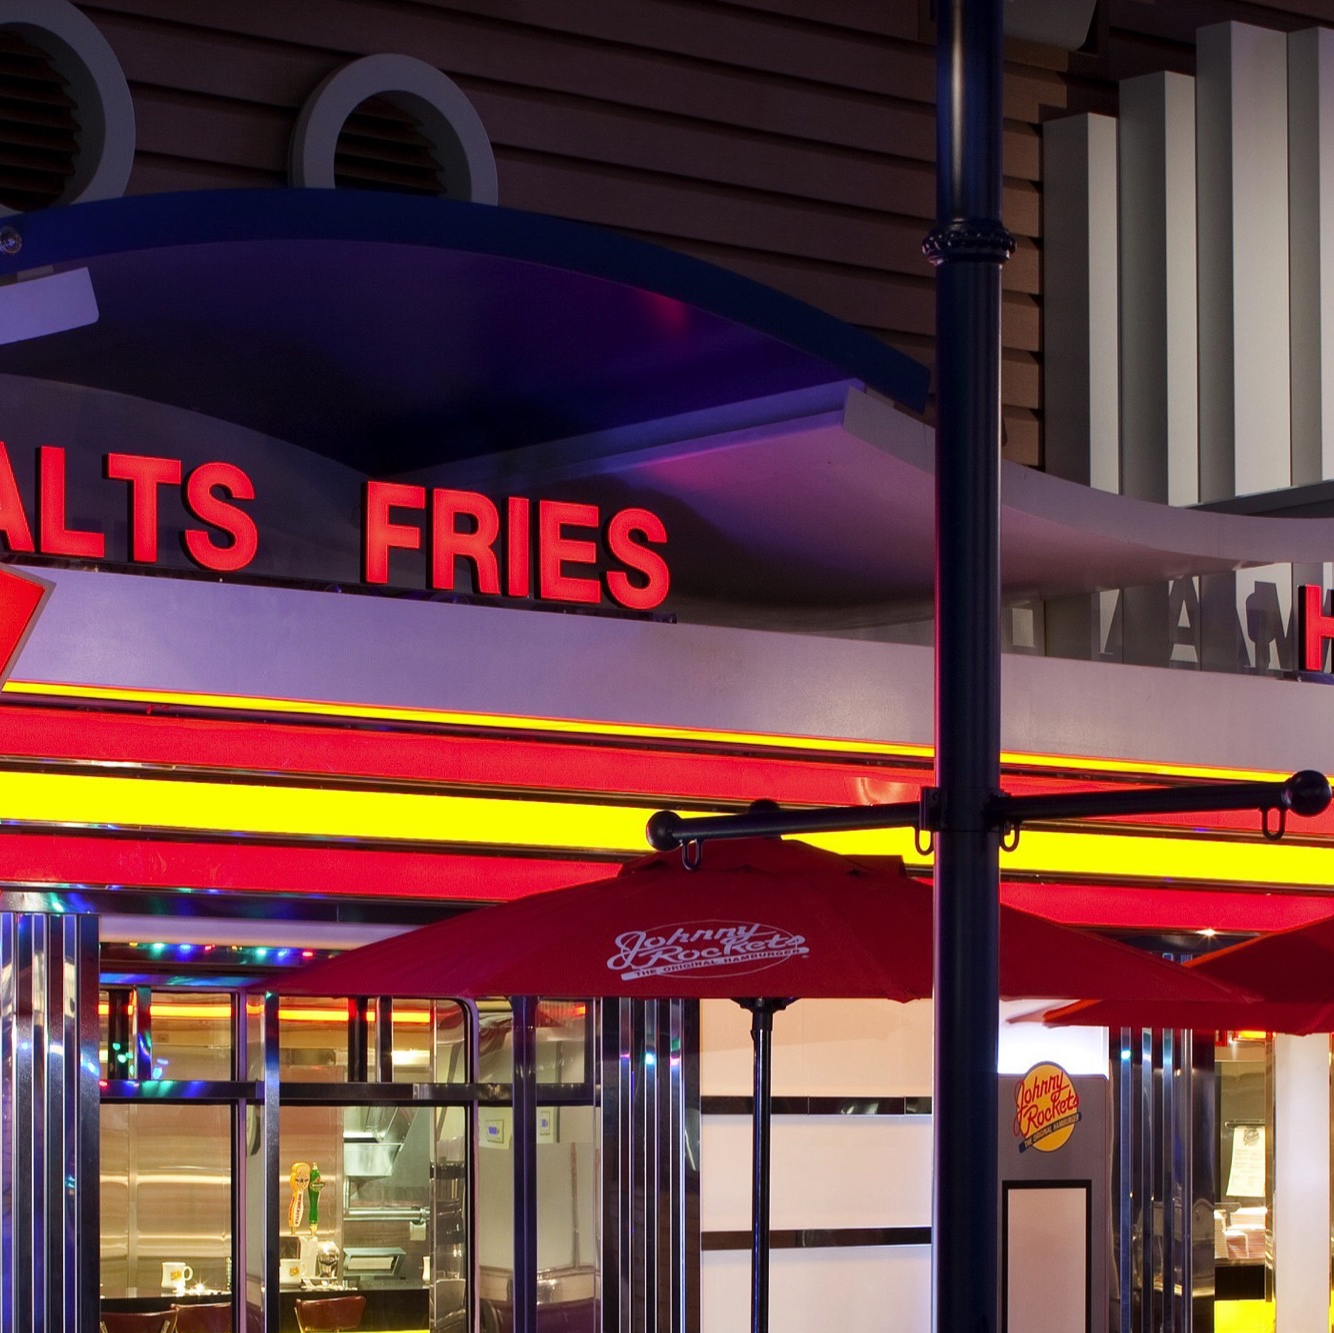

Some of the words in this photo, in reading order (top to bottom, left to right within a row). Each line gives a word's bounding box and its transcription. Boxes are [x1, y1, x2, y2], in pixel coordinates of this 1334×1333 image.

[364, 480, 671, 610] FRIES
[607, 923, 777, 971] Johnny
[631, 934, 806, 970] Rockets
[634, 968, 658, 978] THE
[662, 959, 716, 973] ORIGINAL
[723, 949, 801, 964] HAMBURGER
[1013, 1070, 1071, 1137] Johnny
[1021, 1089, 1080, 1137] Rockets
